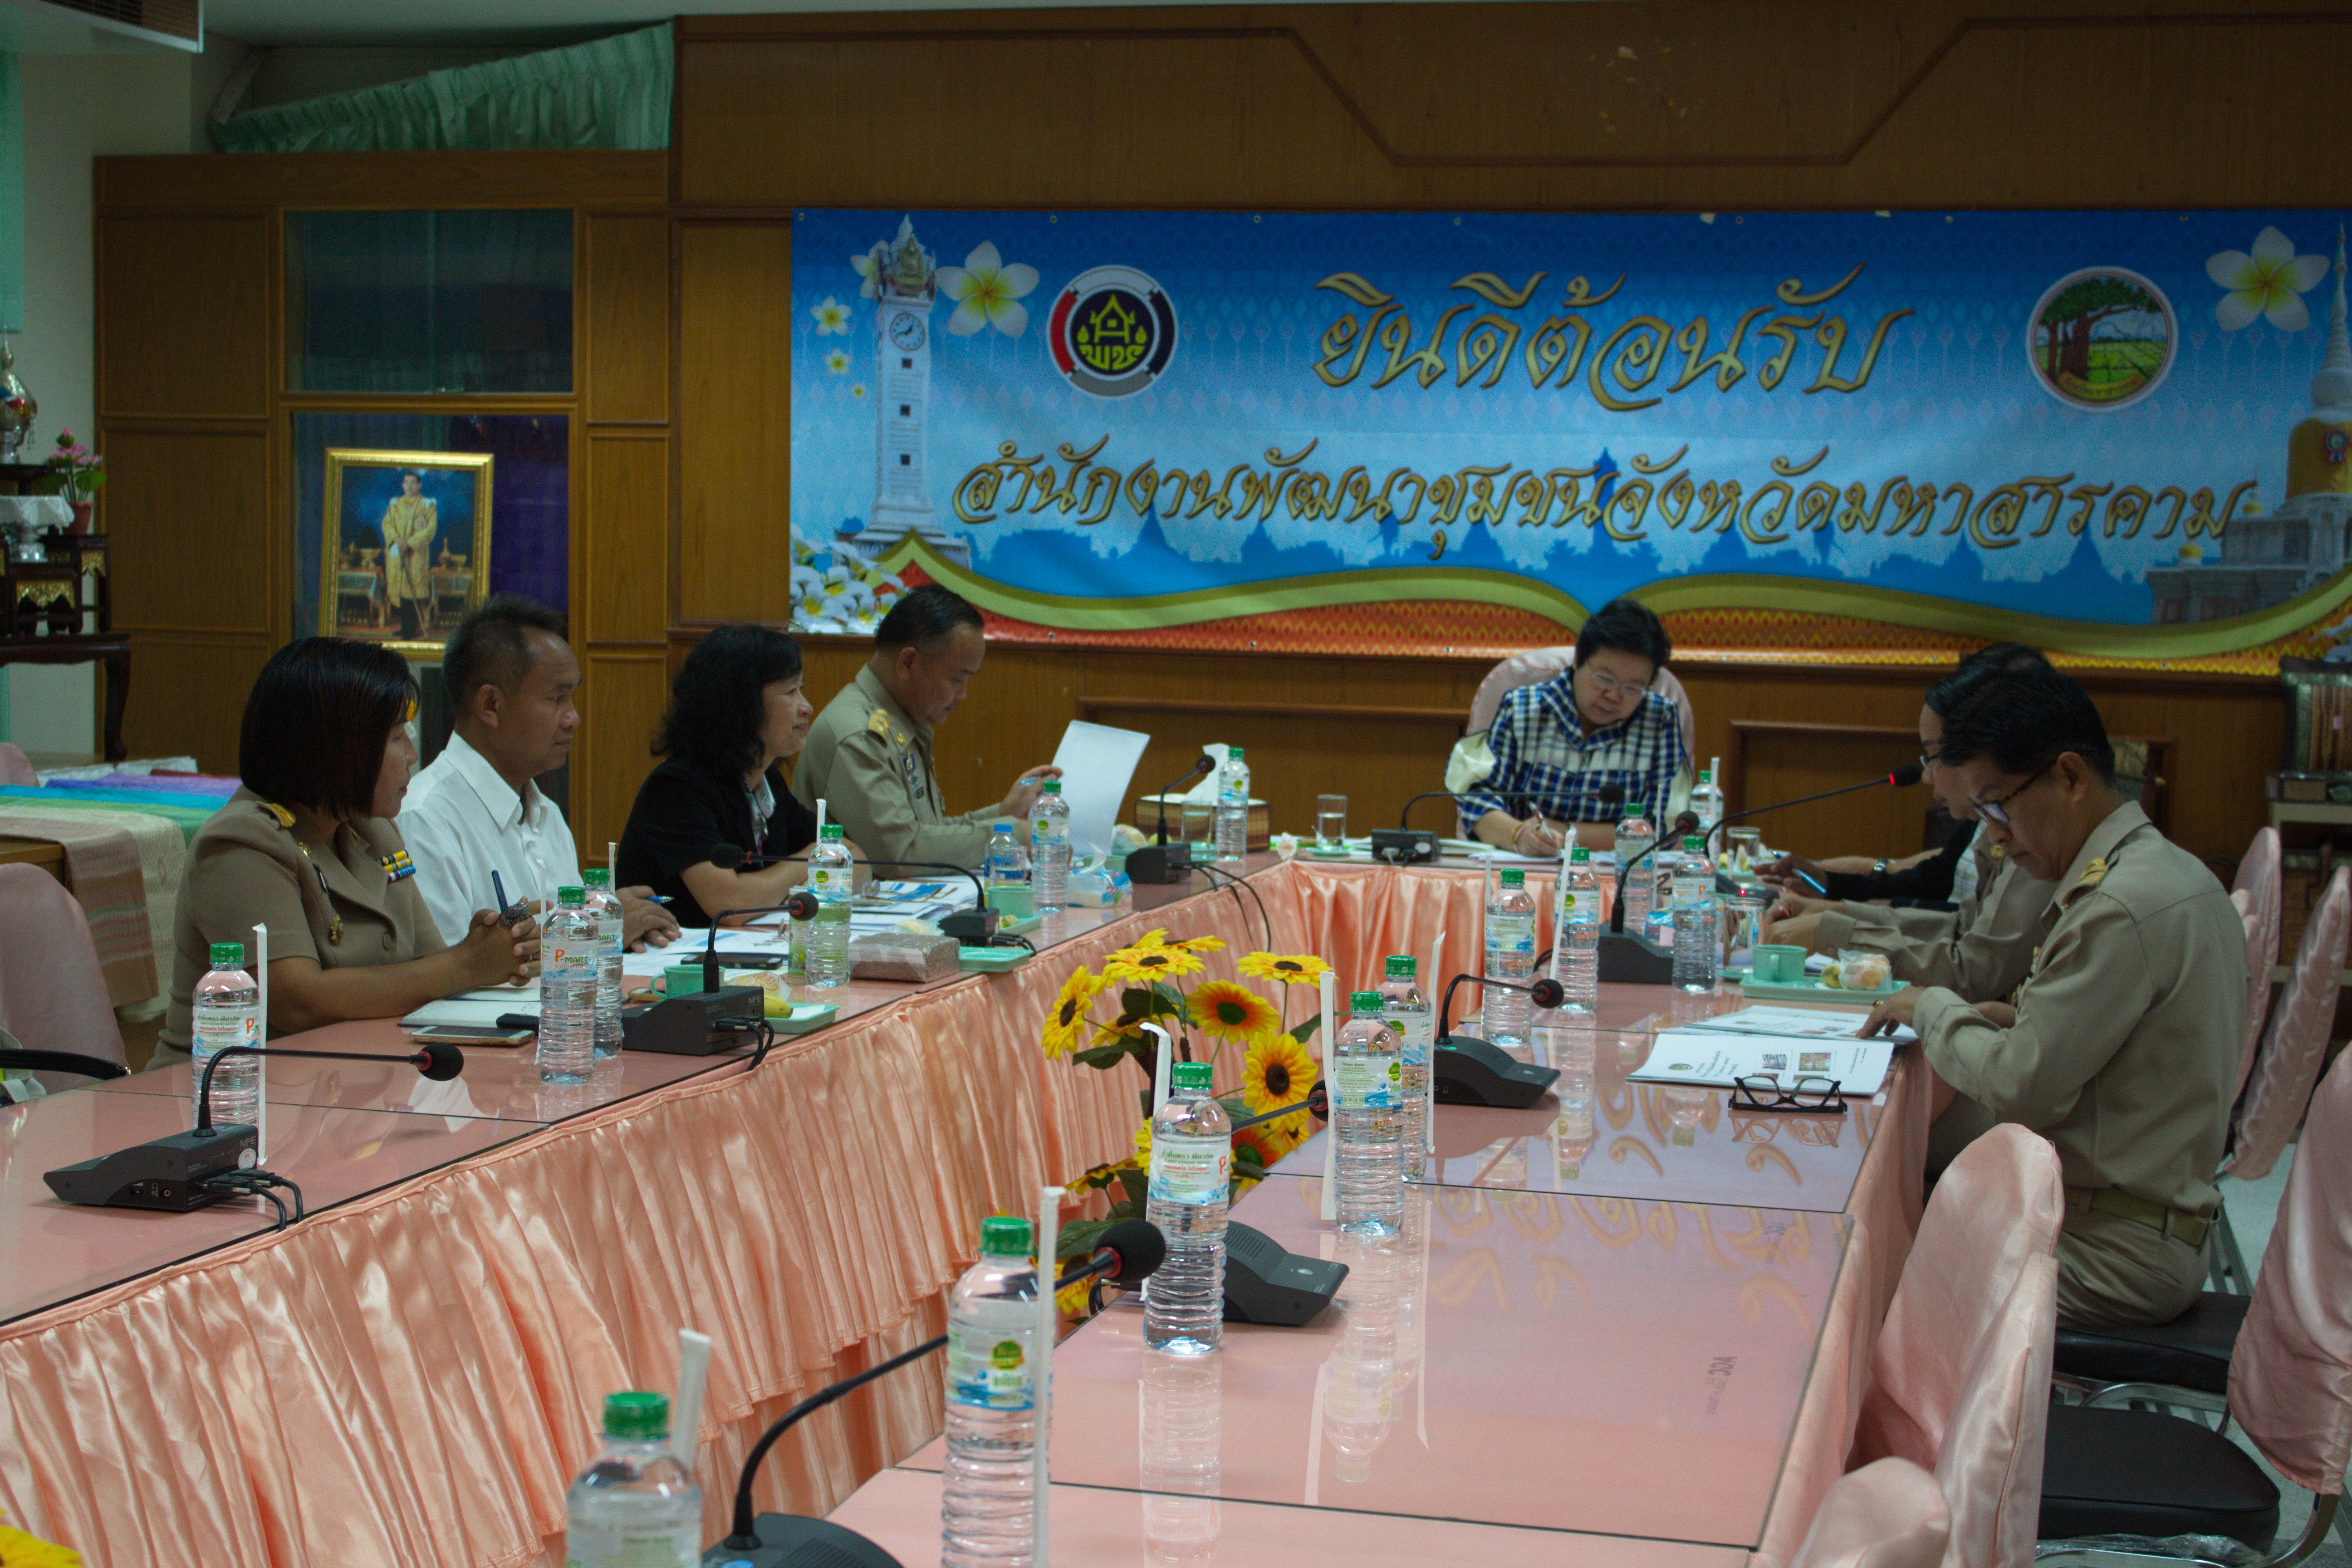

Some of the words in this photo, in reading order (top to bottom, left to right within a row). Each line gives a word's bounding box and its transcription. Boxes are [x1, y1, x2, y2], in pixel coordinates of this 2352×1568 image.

[1313, 260, 1915, 411] ยินดีต้อนรับ
[952, 433, 2258, 560] สำนักงานพัฒนาชุมชนจังหวัดมหาสารคาม
[554, 949, 589, 963] P-MART
[748, 995, 762, 1005] NPE
